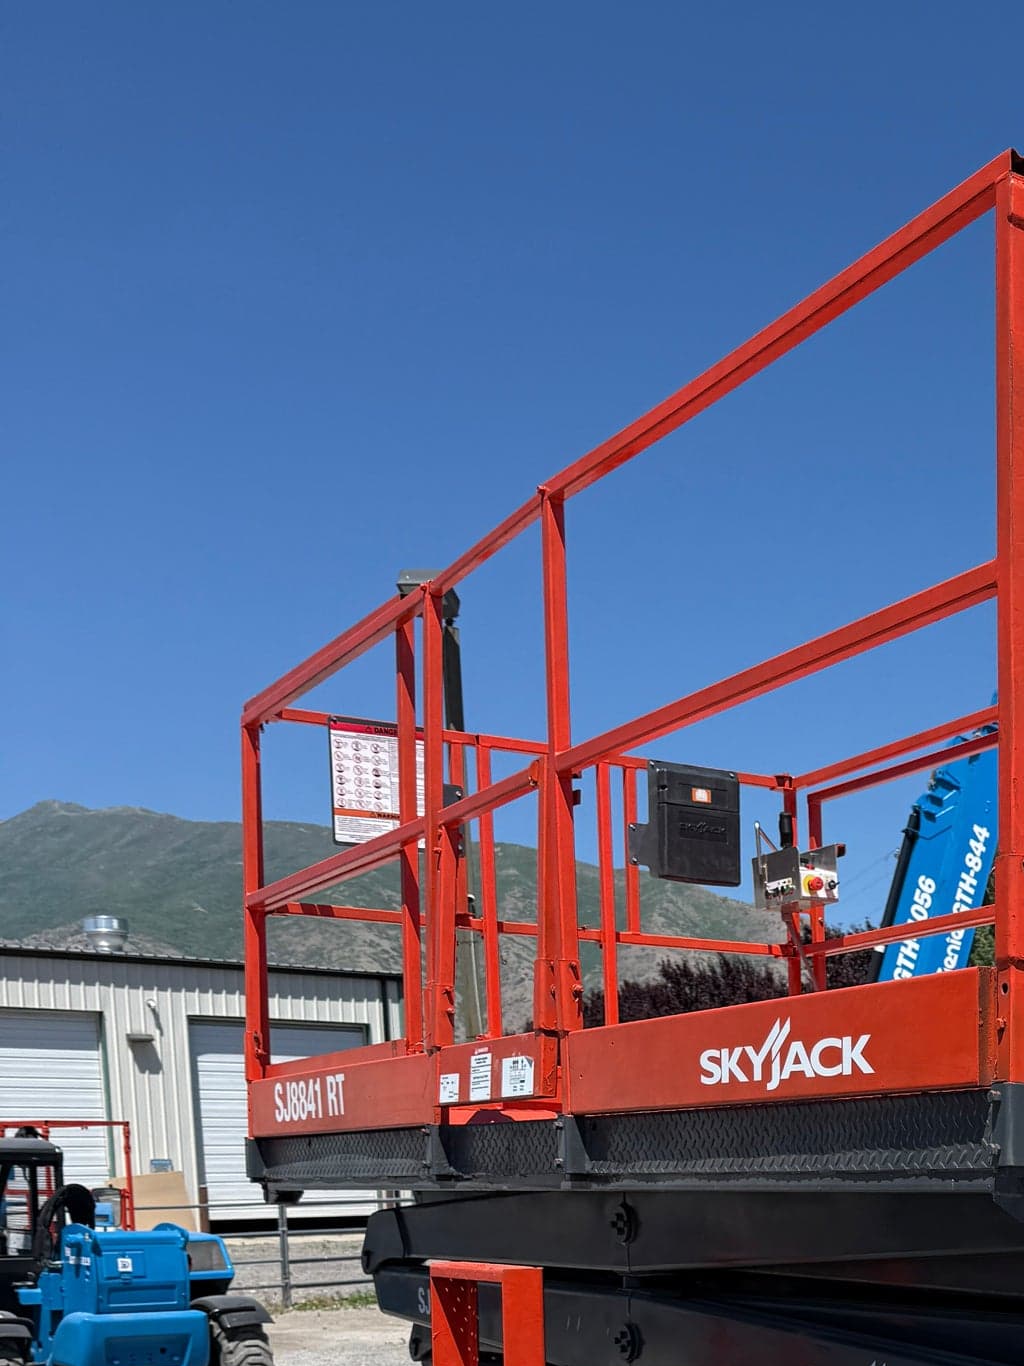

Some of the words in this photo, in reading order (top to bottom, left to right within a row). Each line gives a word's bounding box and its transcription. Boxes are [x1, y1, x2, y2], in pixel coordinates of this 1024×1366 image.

[893, 875, 936, 980] GTH056
[699, 1016, 876, 1091] SKYJACK
[274, 1077, 323, 1123] SJ8841
[326, 1073, 345, 1117] RT
